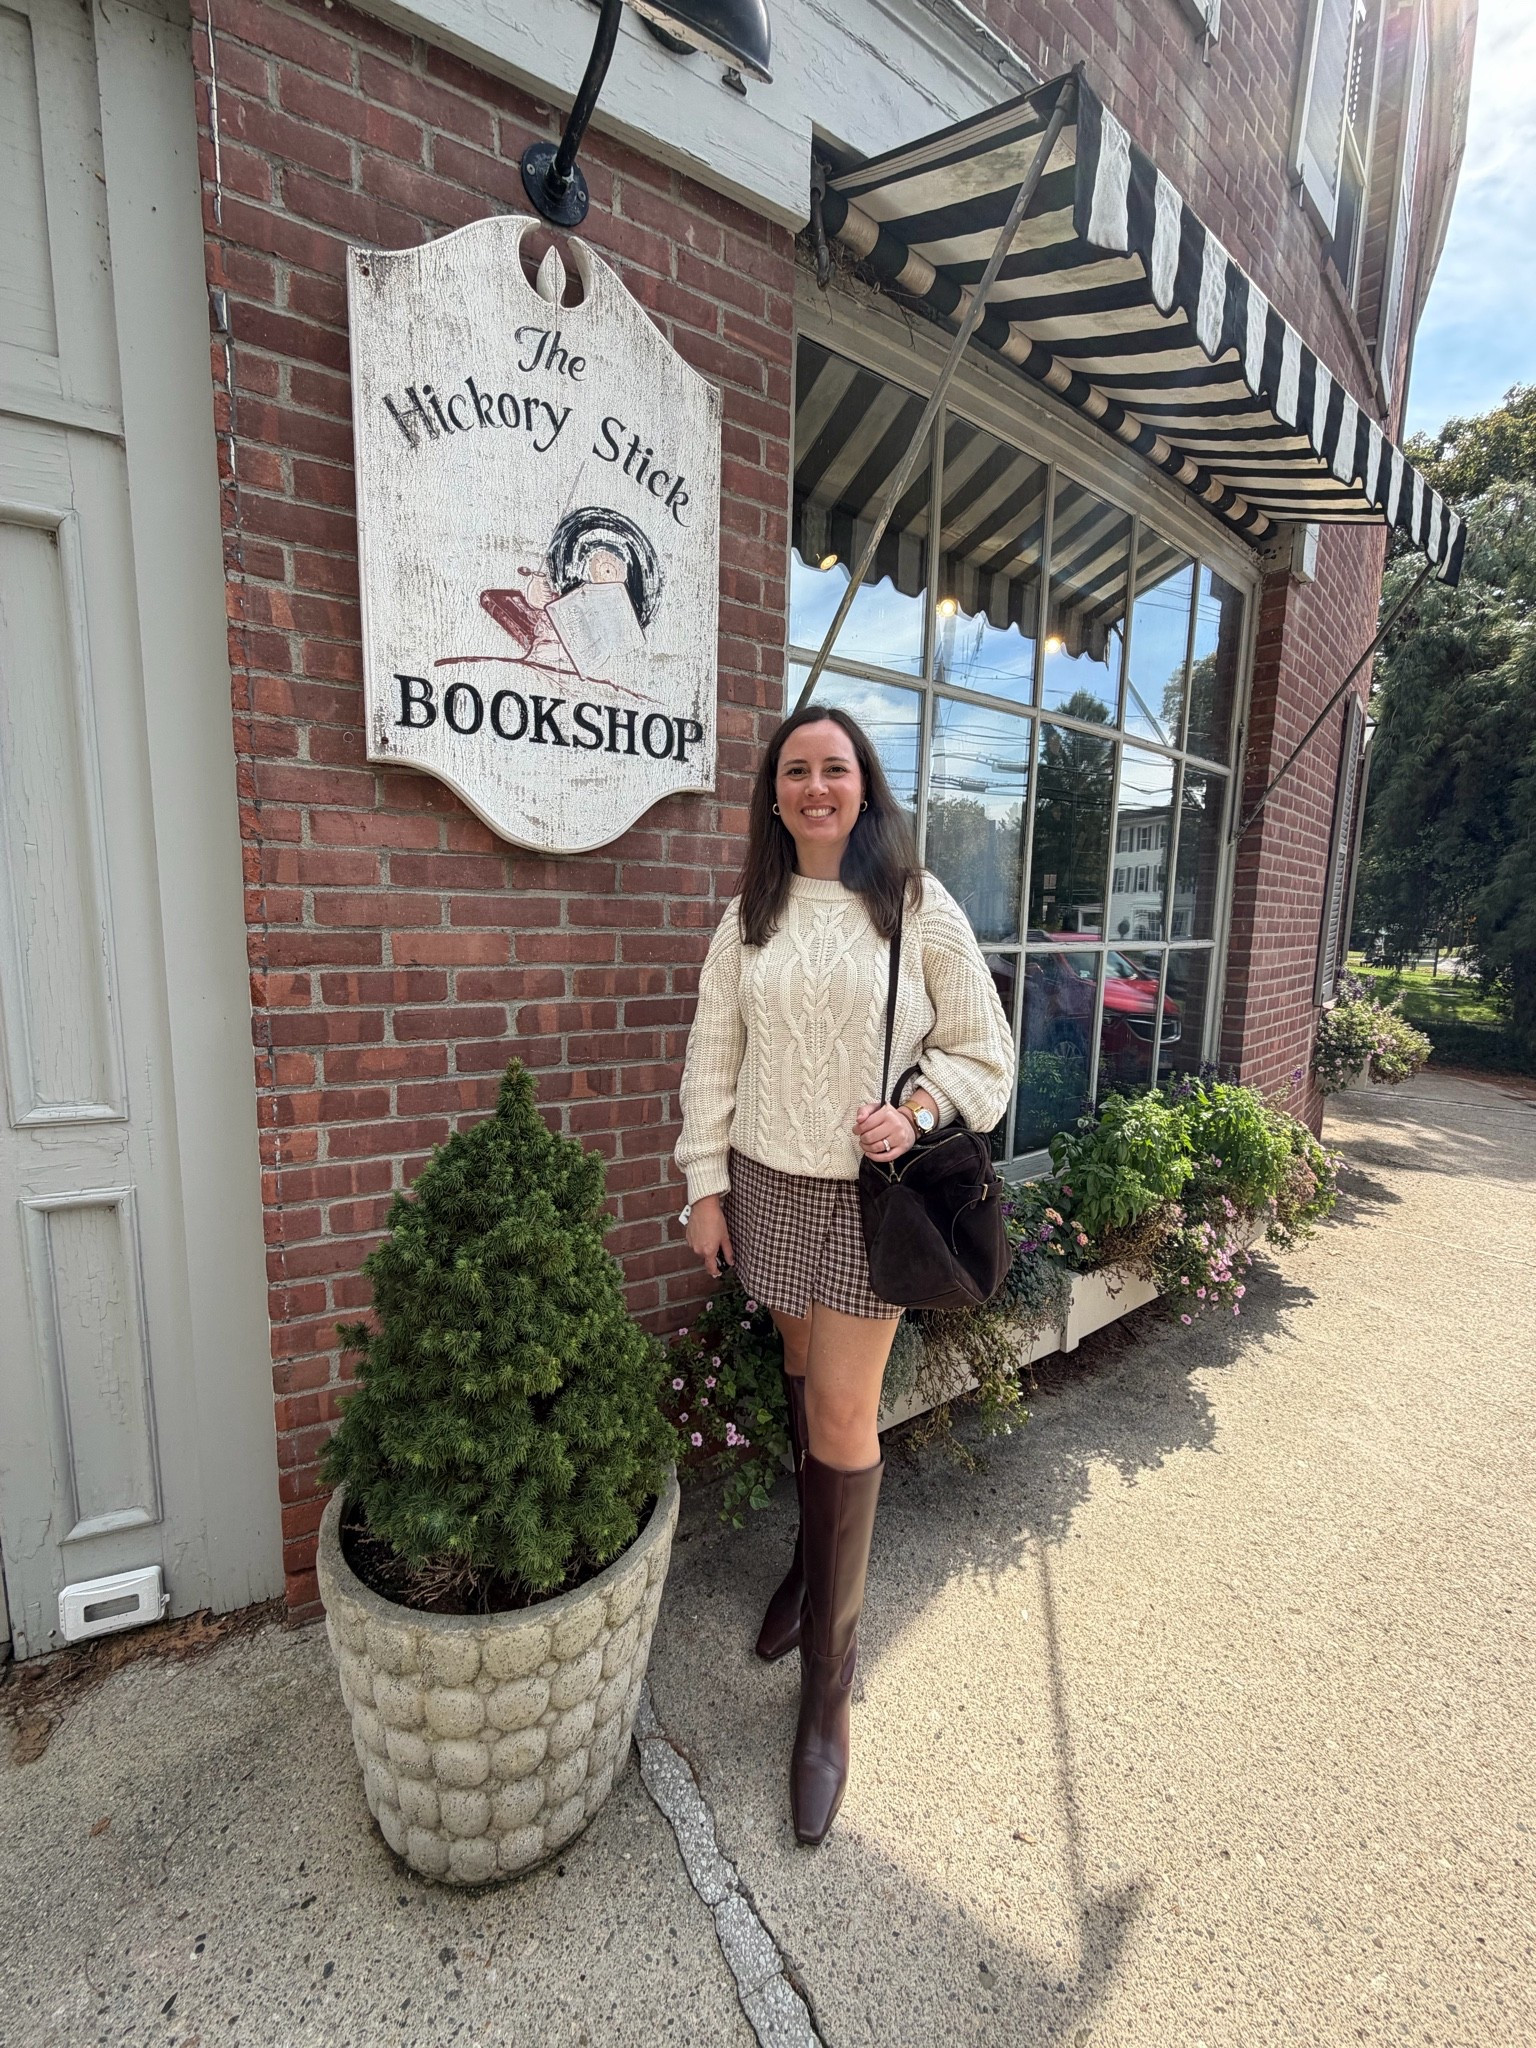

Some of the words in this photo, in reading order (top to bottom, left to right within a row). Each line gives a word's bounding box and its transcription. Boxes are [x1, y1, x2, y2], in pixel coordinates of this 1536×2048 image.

[514, 325, 588, 382] The
[381, 375, 574, 453] Hickory
[592, 416, 692, 528] Stick
[393, 673, 704, 763] BOOKSHOP
